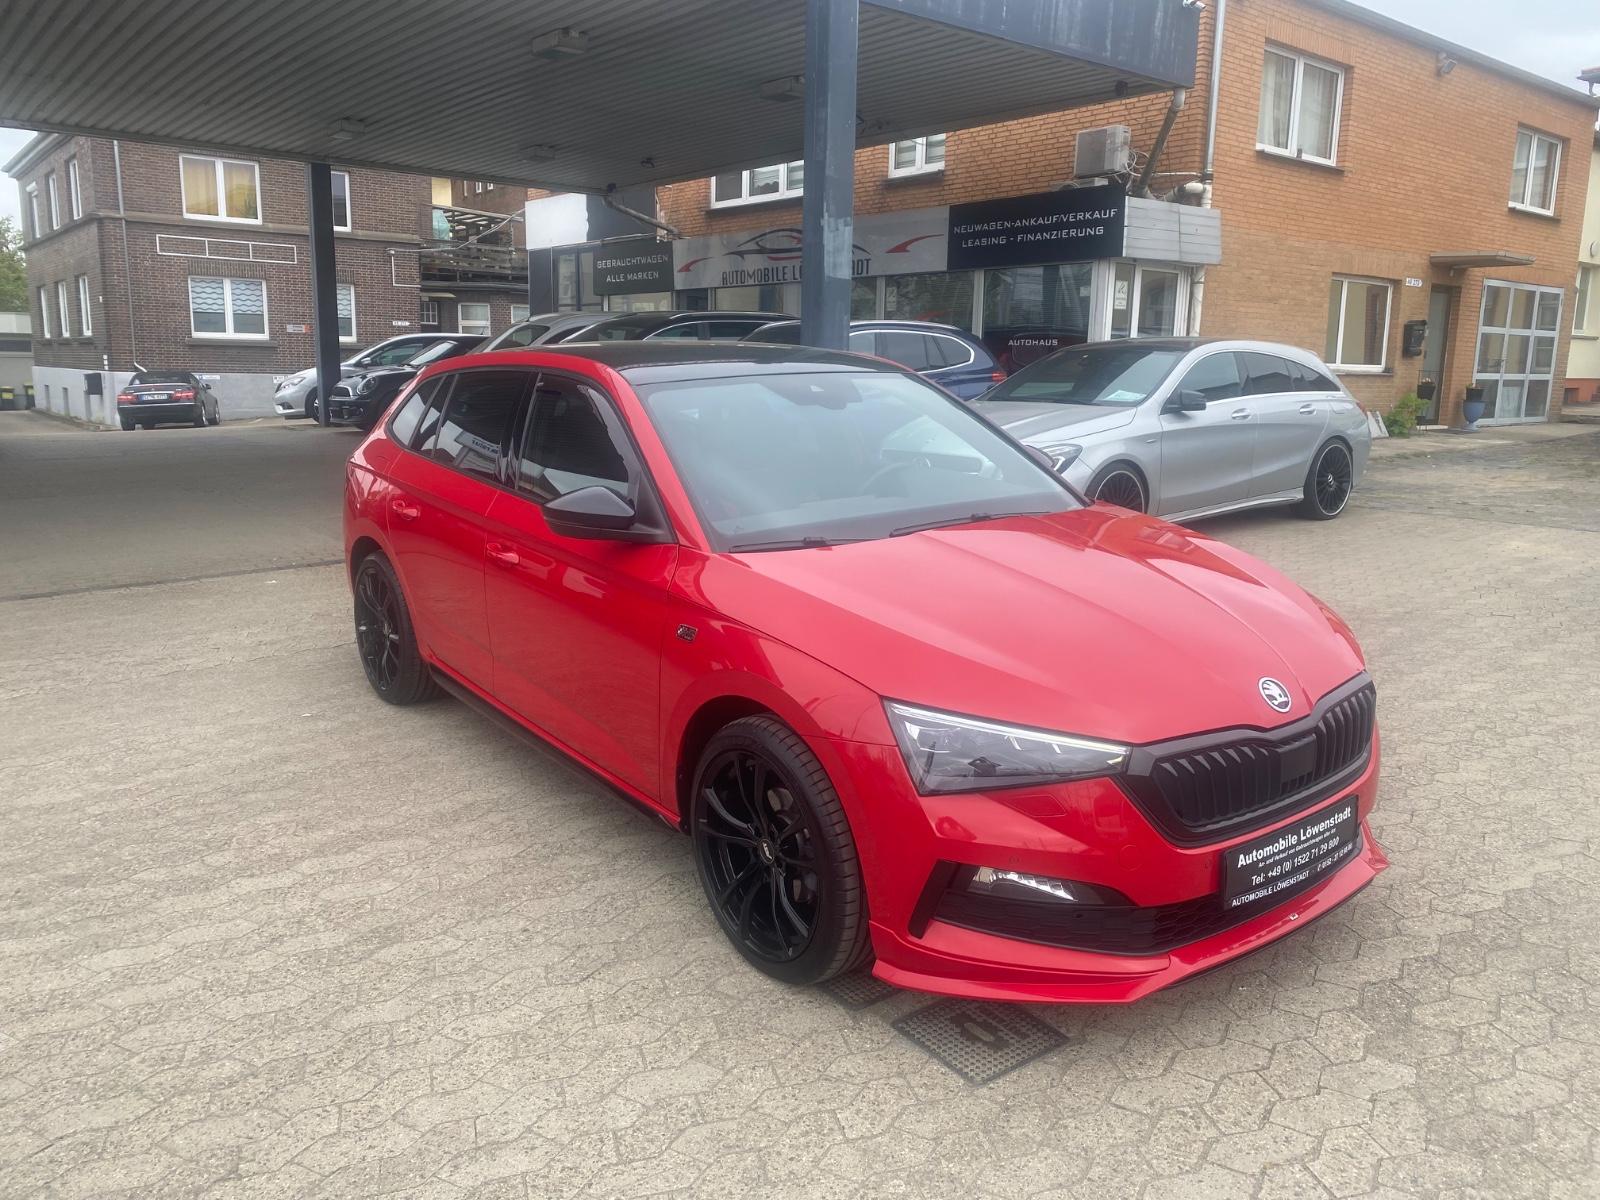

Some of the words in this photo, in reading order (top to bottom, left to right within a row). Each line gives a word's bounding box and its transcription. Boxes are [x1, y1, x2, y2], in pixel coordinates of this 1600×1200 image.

[953, 208, 1118, 234] NEUWAGEN-ANKAUF/VERKAUF
[962, 235, 1007, 248] LEASING
[1017, 226, 1104, 243] FINANZIERUNG
[597, 254, 669, 269] GEBRAUCHTWAGEN
[606, 273, 625, 283] ALLE
[627, 271, 659, 281] MARKEN
[722, 265, 788, 286] AUTOMOBILE
[1008, 338, 1058, 346] AUTOHAUS
[1237, 832, 1298, 868] Automobile
[1300, 806, 1352, 840] Löwenstadt
[1251, 872, 1266, 886] Tel:
[1267, 865, 1281, 878] +49
[1282, 859, 1292, 874] (0)
[1294, 851, 1310, 867] 1522
[1311, 847, 1318, 859] 71
[1320, 842, 1328, 855] 29
[1328, 836, 1340, 849] 800
[1231, 886, 1273, 907] AUTOMOBILE
[1273, 870, 1310, 892] LÖWENSTADT
